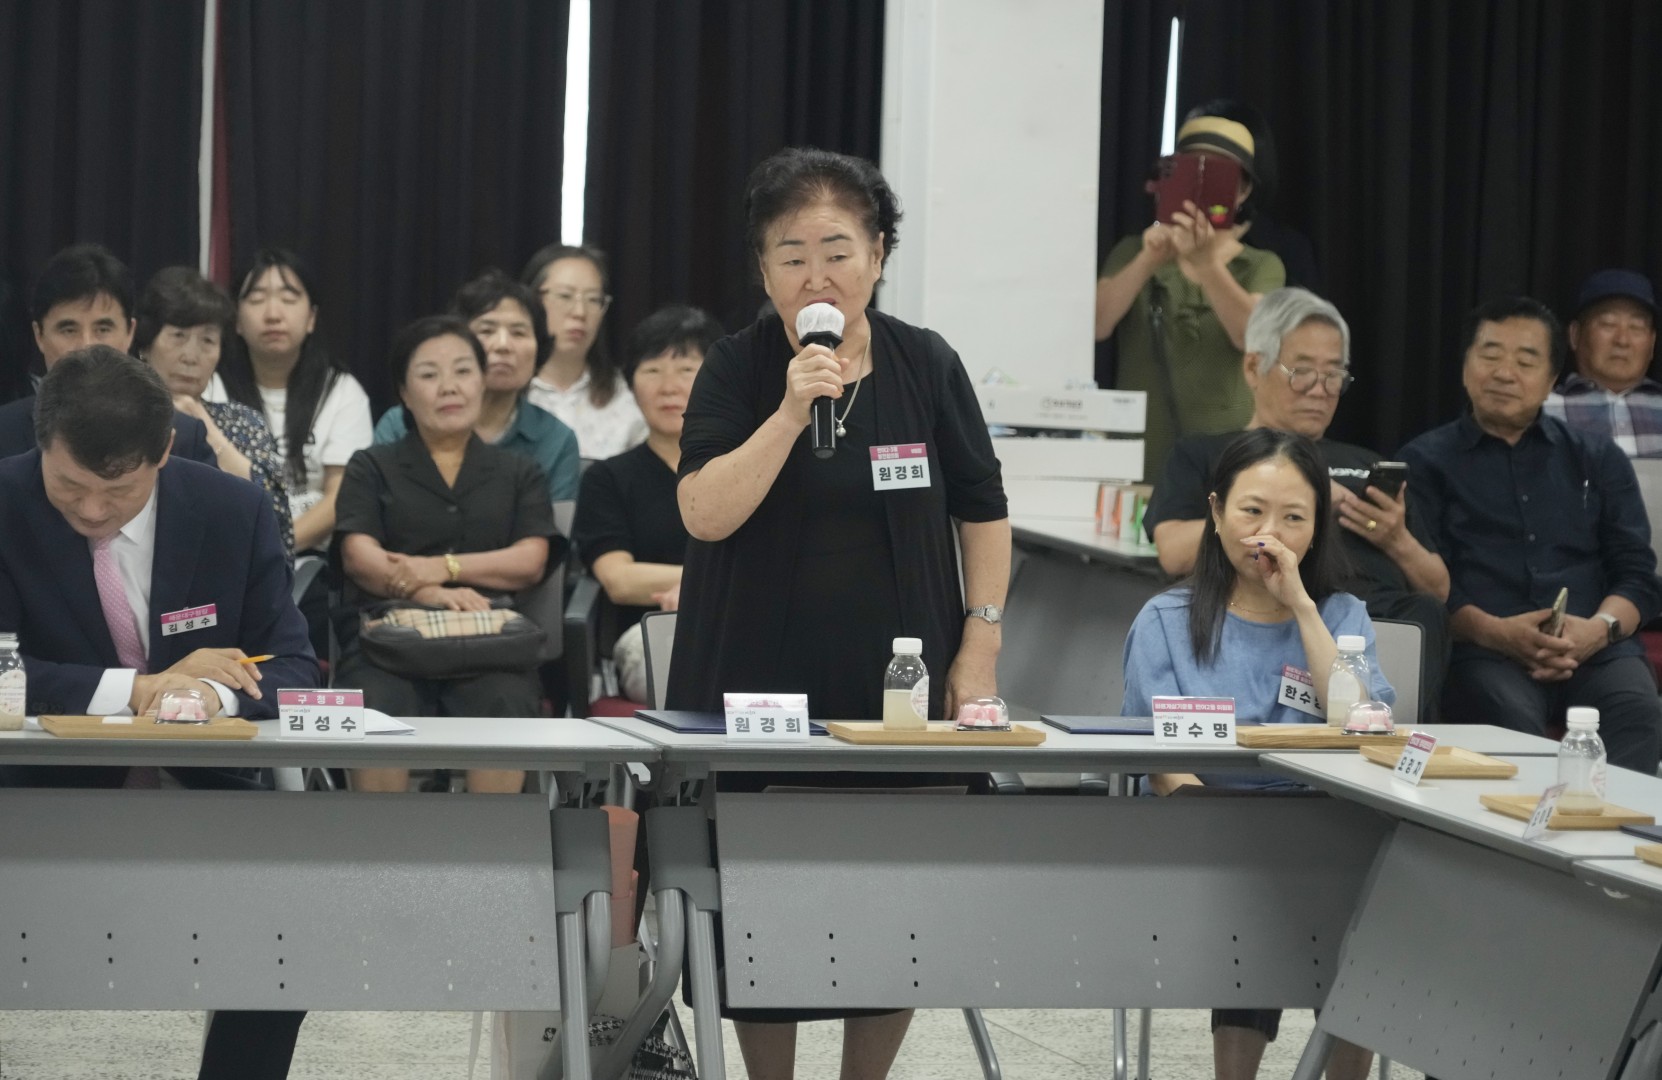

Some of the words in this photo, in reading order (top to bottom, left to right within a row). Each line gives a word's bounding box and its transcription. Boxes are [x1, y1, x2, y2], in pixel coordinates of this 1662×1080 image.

[878, 464, 924, 482] 원경희
[168, 617, 210, 633] 김성수
[297, 694, 345, 705] 구청장
[288, 715, 357, 733] 김성수
[734, 717, 801, 733] 원경희
[1162, 721, 1229, 738] 한수명
